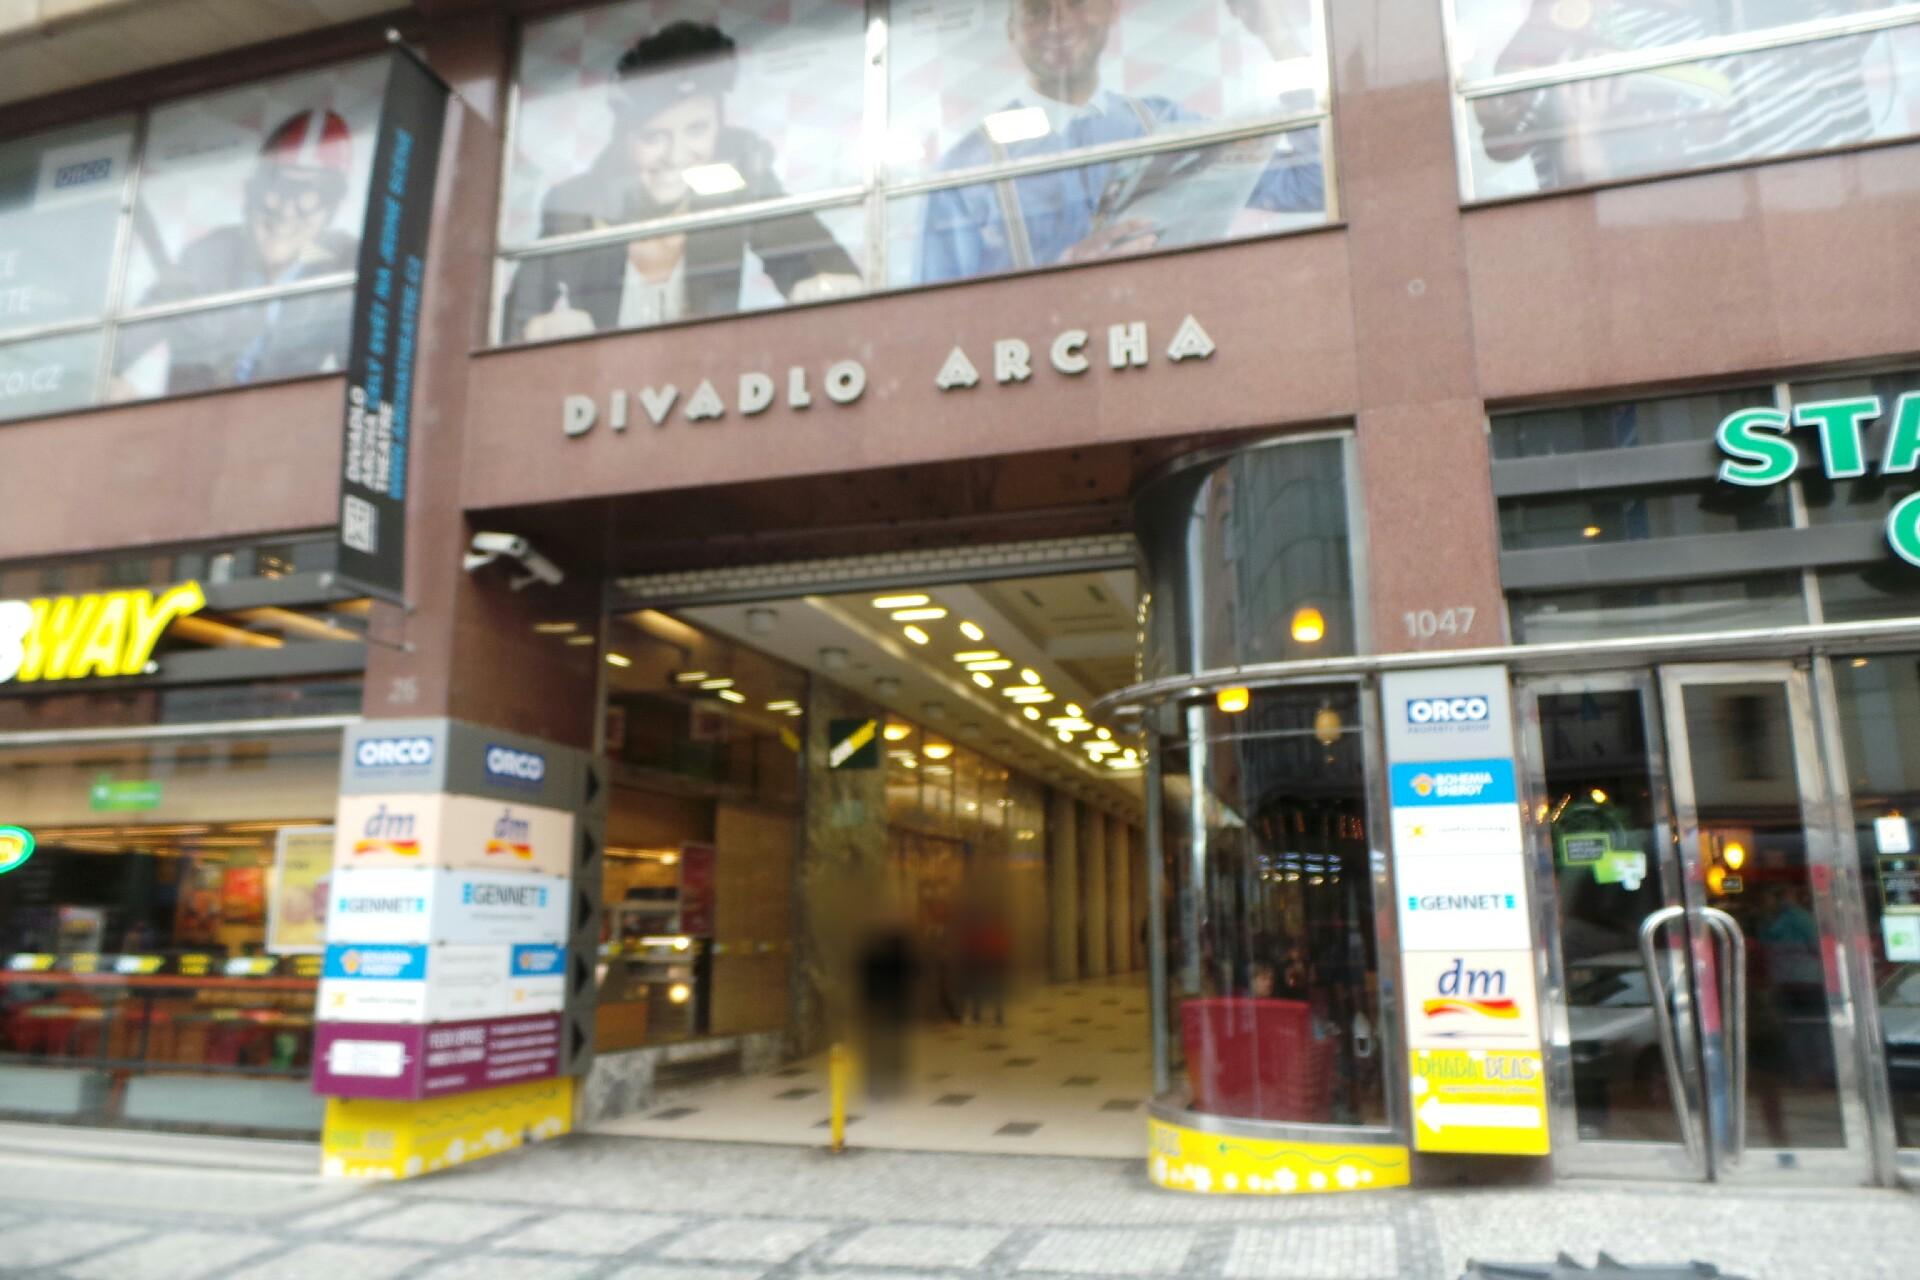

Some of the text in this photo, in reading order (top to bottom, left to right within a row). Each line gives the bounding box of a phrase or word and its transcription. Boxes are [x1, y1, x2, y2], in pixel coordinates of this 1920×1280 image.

[562, 313, 1217, 437] DIVADLO ARCHA
[1402, 606, 1478, 639] 1047
[1410, 697, 1488, 723] ORCO
[357, 738, 433, 766] ORCO
[486, 747, 545, 781] ORCO
[1435, 771, 1494, 786] BOHEMIA
[364, 803, 416, 839] dm
[494, 807, 529, 841] dm
[348, 897, 413, 914] GENNET
[473, 883, 538, 907] GENNET
[1419, 894, 1501, 912] GENNET
[1437, 957, 1507, 997] dm
